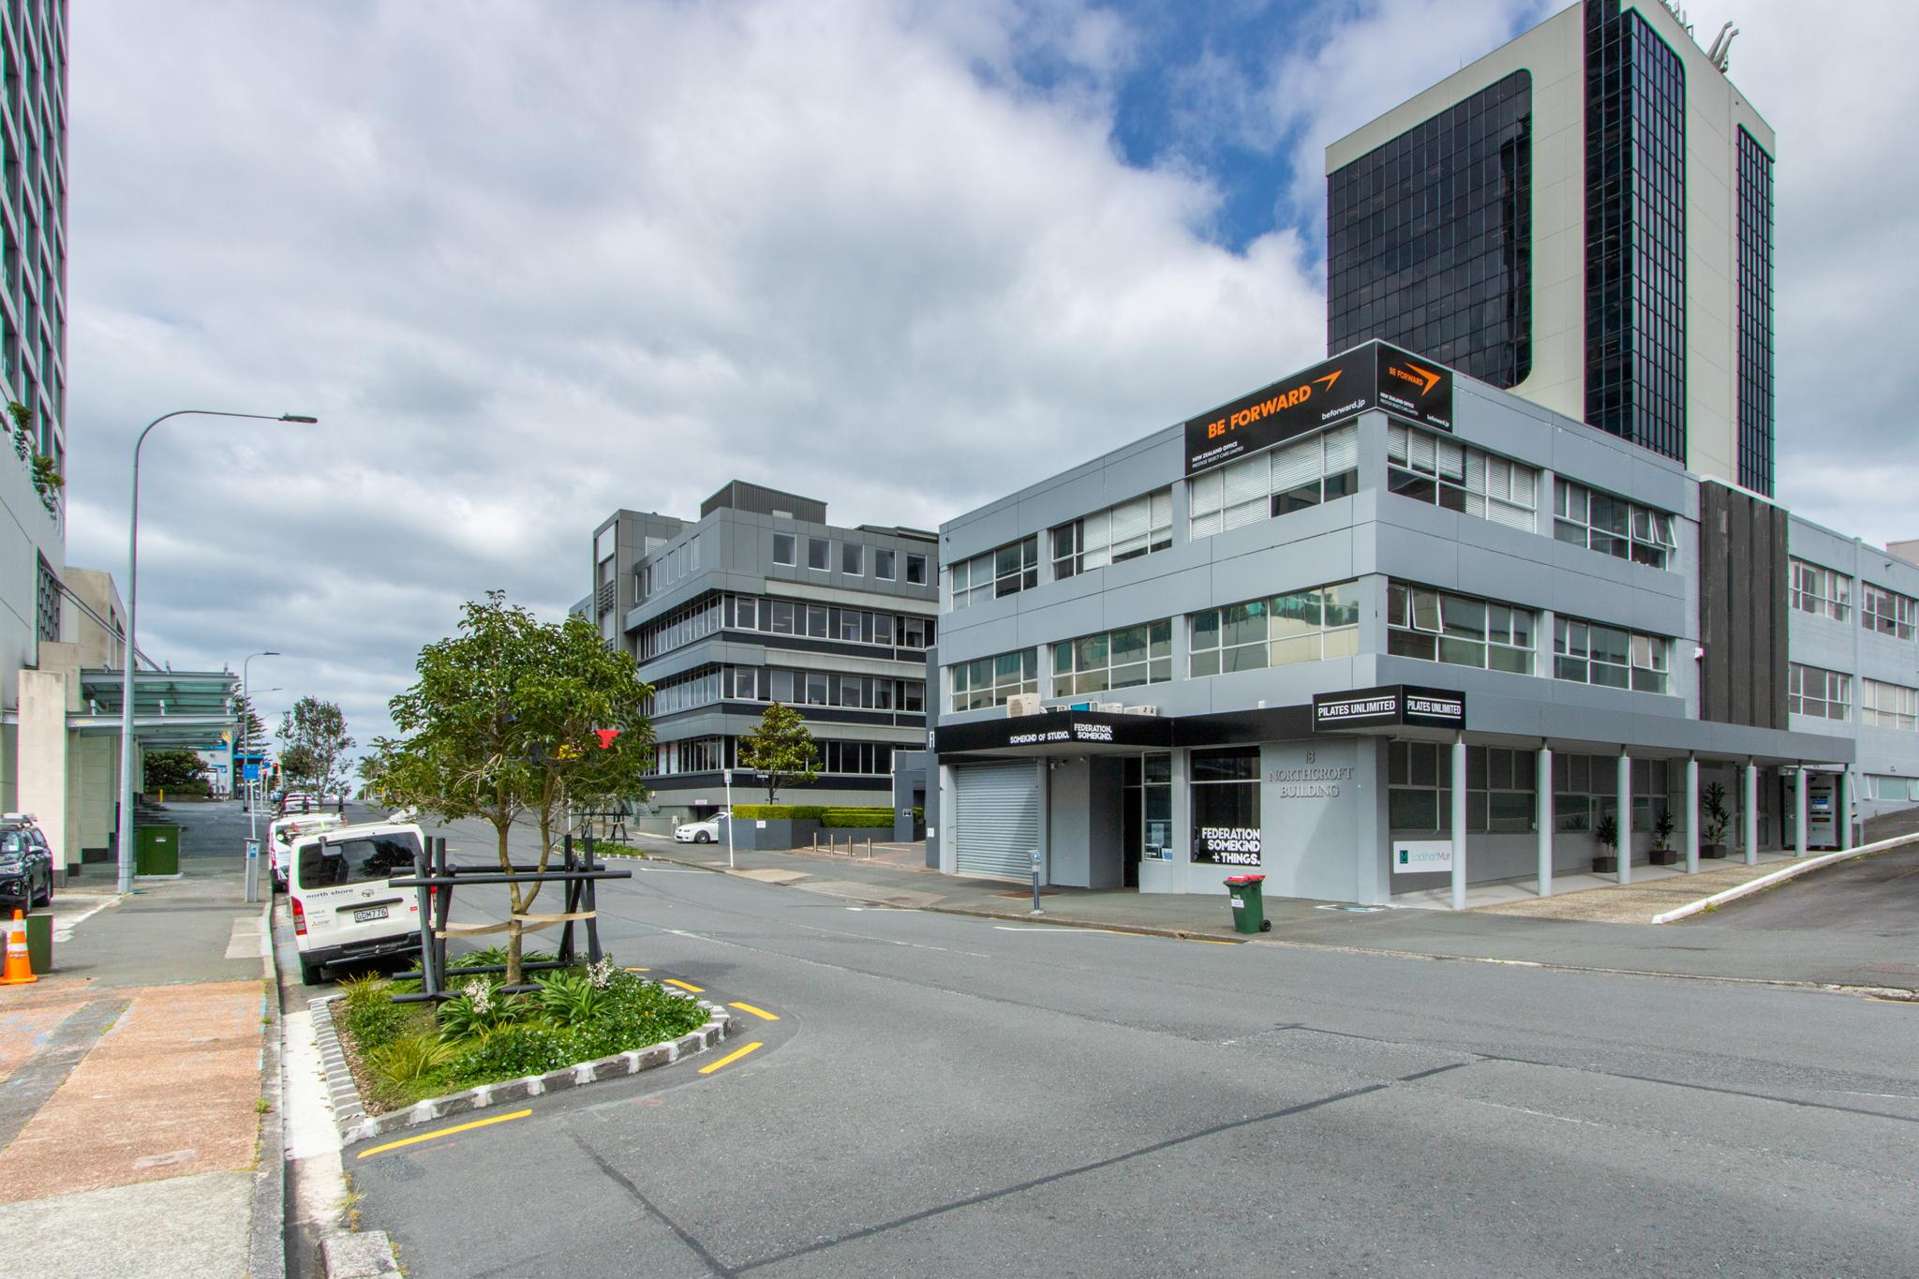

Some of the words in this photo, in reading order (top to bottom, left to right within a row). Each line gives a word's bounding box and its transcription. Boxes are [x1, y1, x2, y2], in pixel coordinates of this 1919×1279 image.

[1397, 370, 1424, 386] FORWARD
[1208, 418, 1226, 439] BE
[1230, 384, 1312, 430] FORWARD
[1321, 398, 1366, 421] beforward.jp
[1318, 704, 1349, 717] PILATES
[1350, 700, 1396, 714] UNLIMITED
[1407, 700, 1431, 712] PILATES
[1431, 703, 1461, 715] UNLIMITED
[1010, 734, 1037, 744] SOMEKIND
[1038, 732, 1046, 741] OF
[1047, 730, 1070, 741] STUDIO.
[1269, 767, 1354, 782] NORTHCROFT
[1280, 784, 1340, 798] BUILDING
[1201, 827, 1260, 839] FEDERATION
[1207, 839, 1260, 851] SOMEKIND
[1221, 852, 1261, 865] THINGS.
